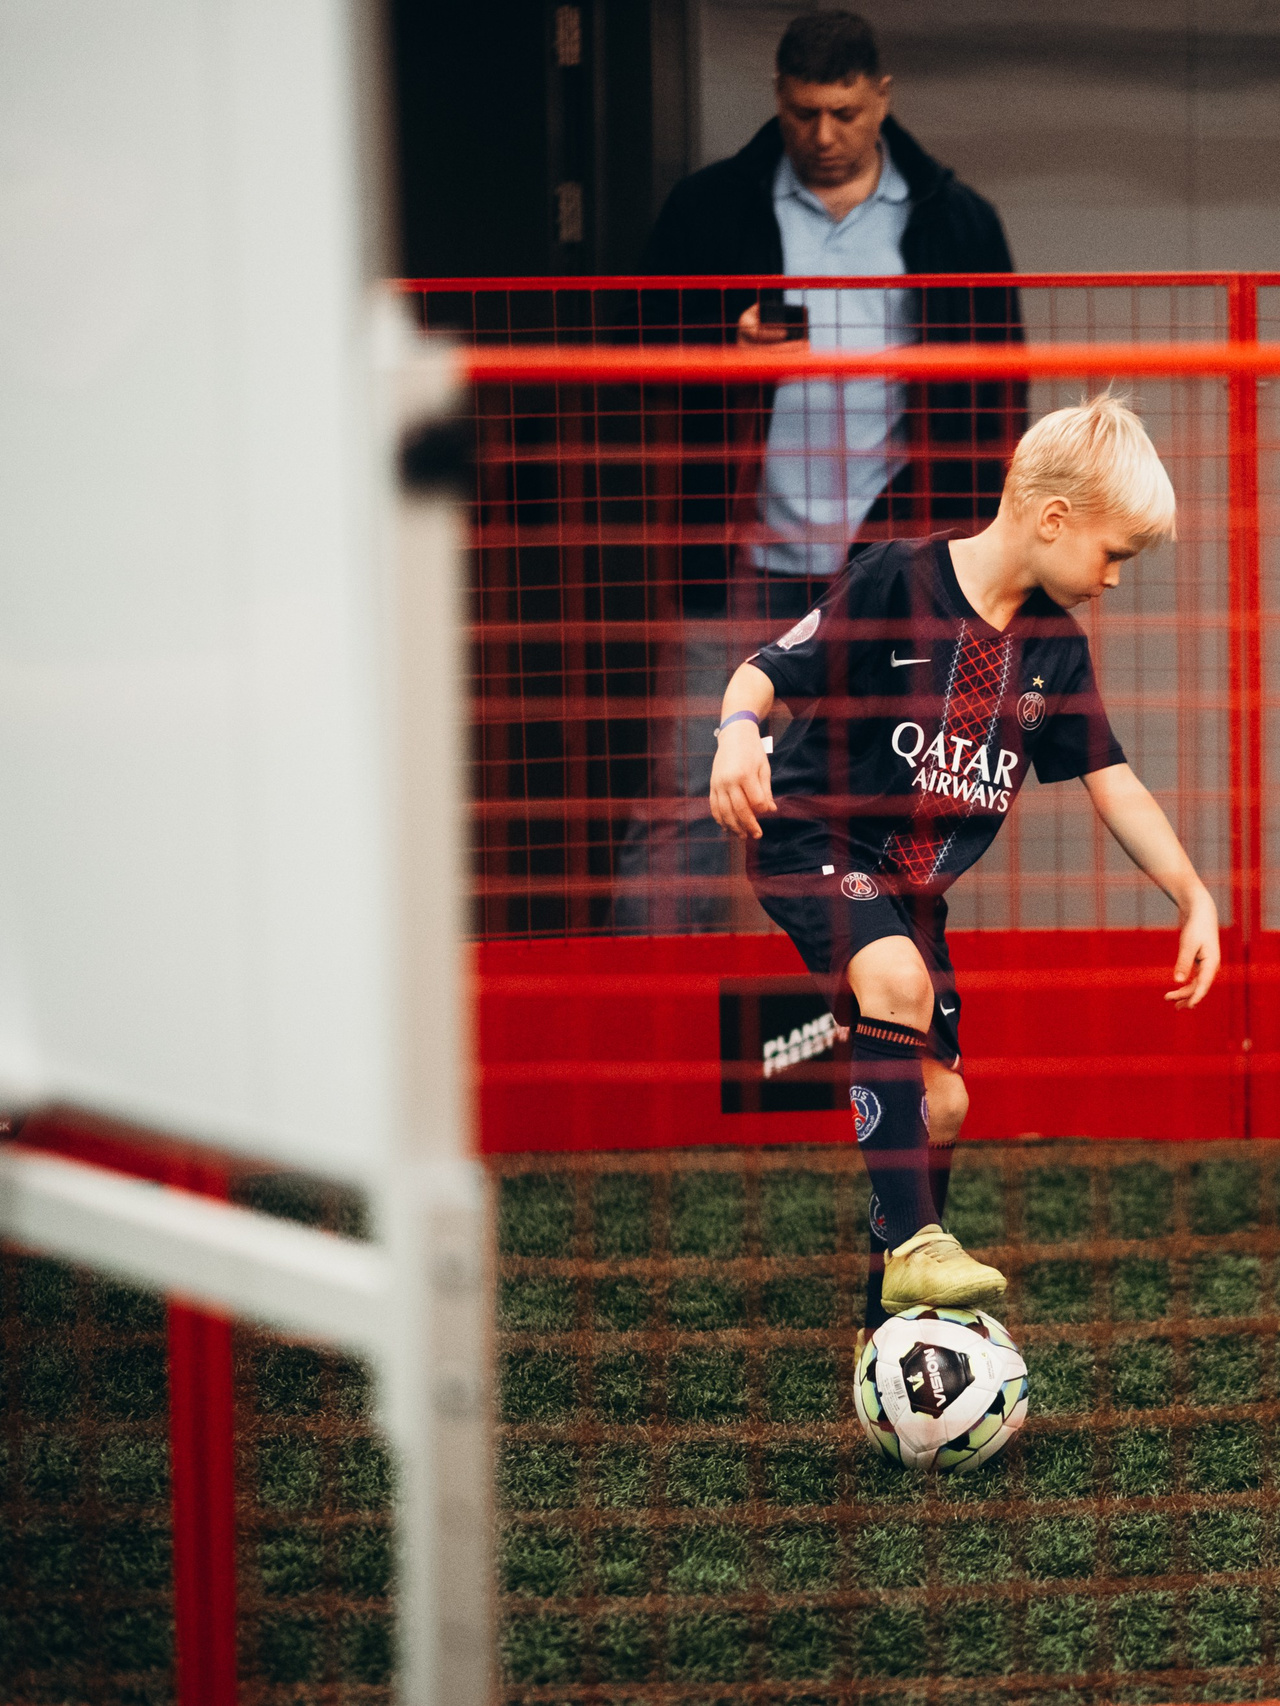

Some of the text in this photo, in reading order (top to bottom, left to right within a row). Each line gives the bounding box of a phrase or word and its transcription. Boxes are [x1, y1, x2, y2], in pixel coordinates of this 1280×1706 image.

[891, 721, 1019, 789] QATAR
[911, 766, 1011, 813] AIRWAYS
[763, 1011, 838, 1058] PLANE
[851, 1089, 869, 1100] RIS
[923, 1347, 947, 1408] VISION
